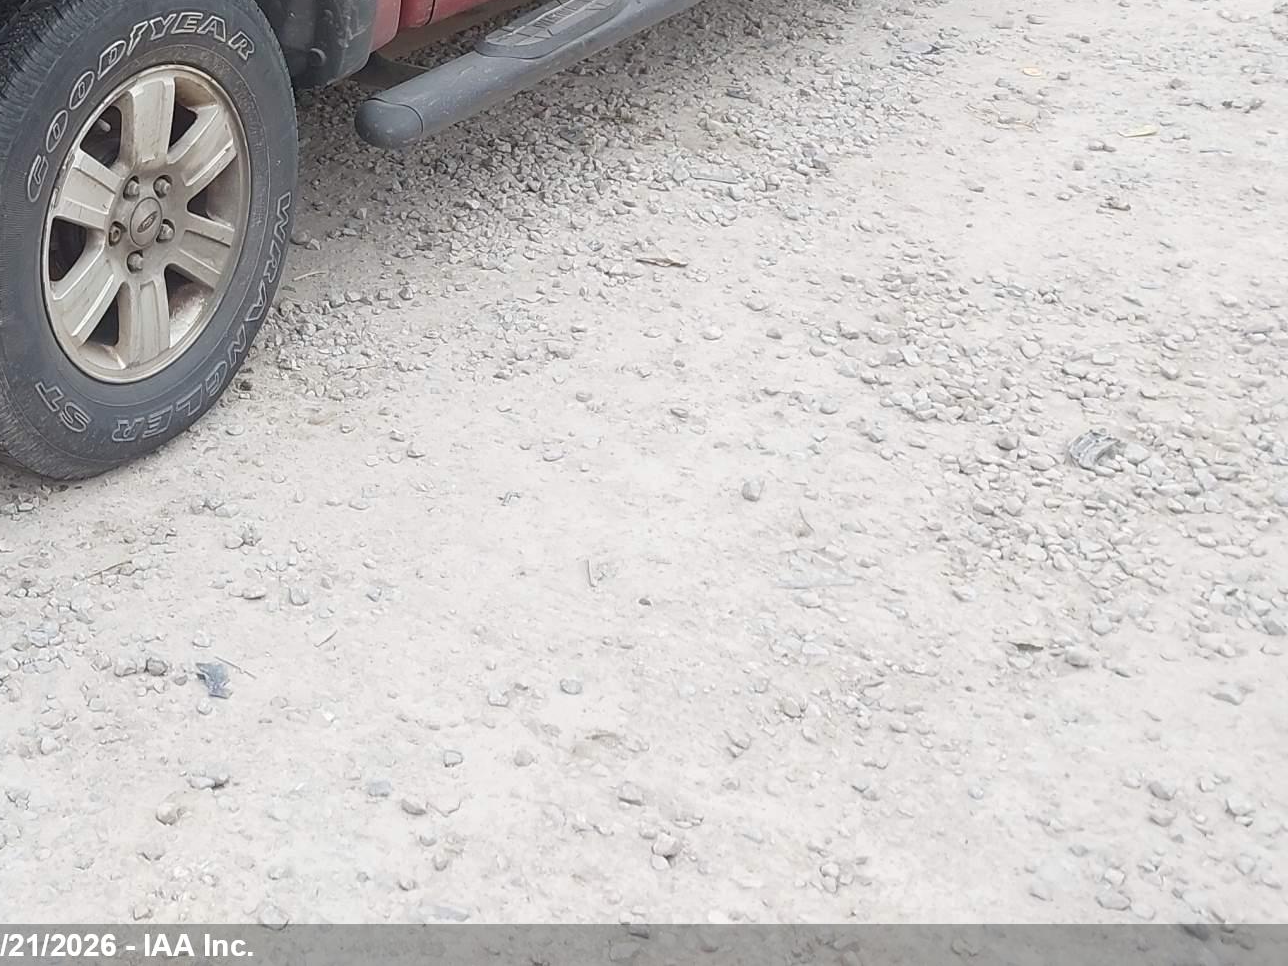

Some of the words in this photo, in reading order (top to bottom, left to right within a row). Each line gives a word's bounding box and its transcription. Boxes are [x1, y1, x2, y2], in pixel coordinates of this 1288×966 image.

[27, 11, 255, 203] GOODYEAR
[35, 381, 93, 433] ST
[112, 192, 292, 442] WRANGLER
